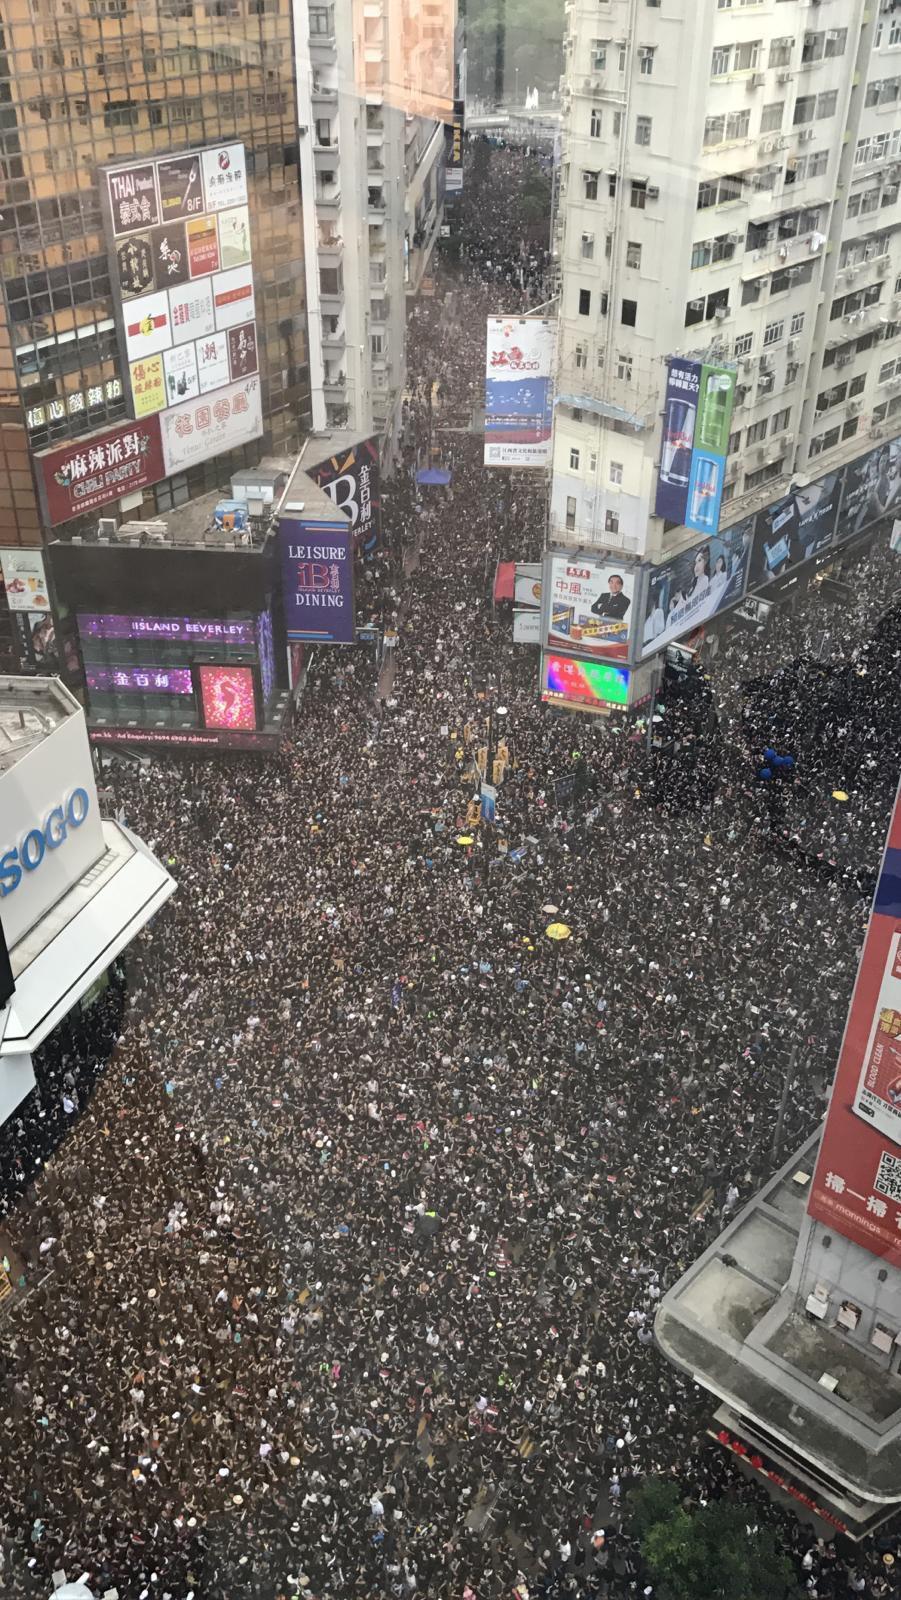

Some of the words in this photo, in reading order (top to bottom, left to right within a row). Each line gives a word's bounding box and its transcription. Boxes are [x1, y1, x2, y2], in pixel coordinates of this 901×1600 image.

[452, 122, 461, 162] IKEA
[111, 174, 135, 199] THAI
[186, 197, 201, 211] 8/F
[70, 432, 140, 481] 麻辣派對
[73, 474, 105, 498] CHILI
[105, 458, 141, 486] PARTY
[321, 474, 359, 527] B
[359, 464, 372, 523] 金百利
[288, 545, 346, 560] LEISURE
[296, 594, 344, 607] DINING
[555, 580, 582, 596] 中風
[186, 623, 244, 635] BEVERLEY
[113, 672, 170, 688] 金百利
[0, 787, 90, 897] SOGO
[825, 1171, 888, 1218] 掃一掃
[836, 1203, 881, 1233] mannings
